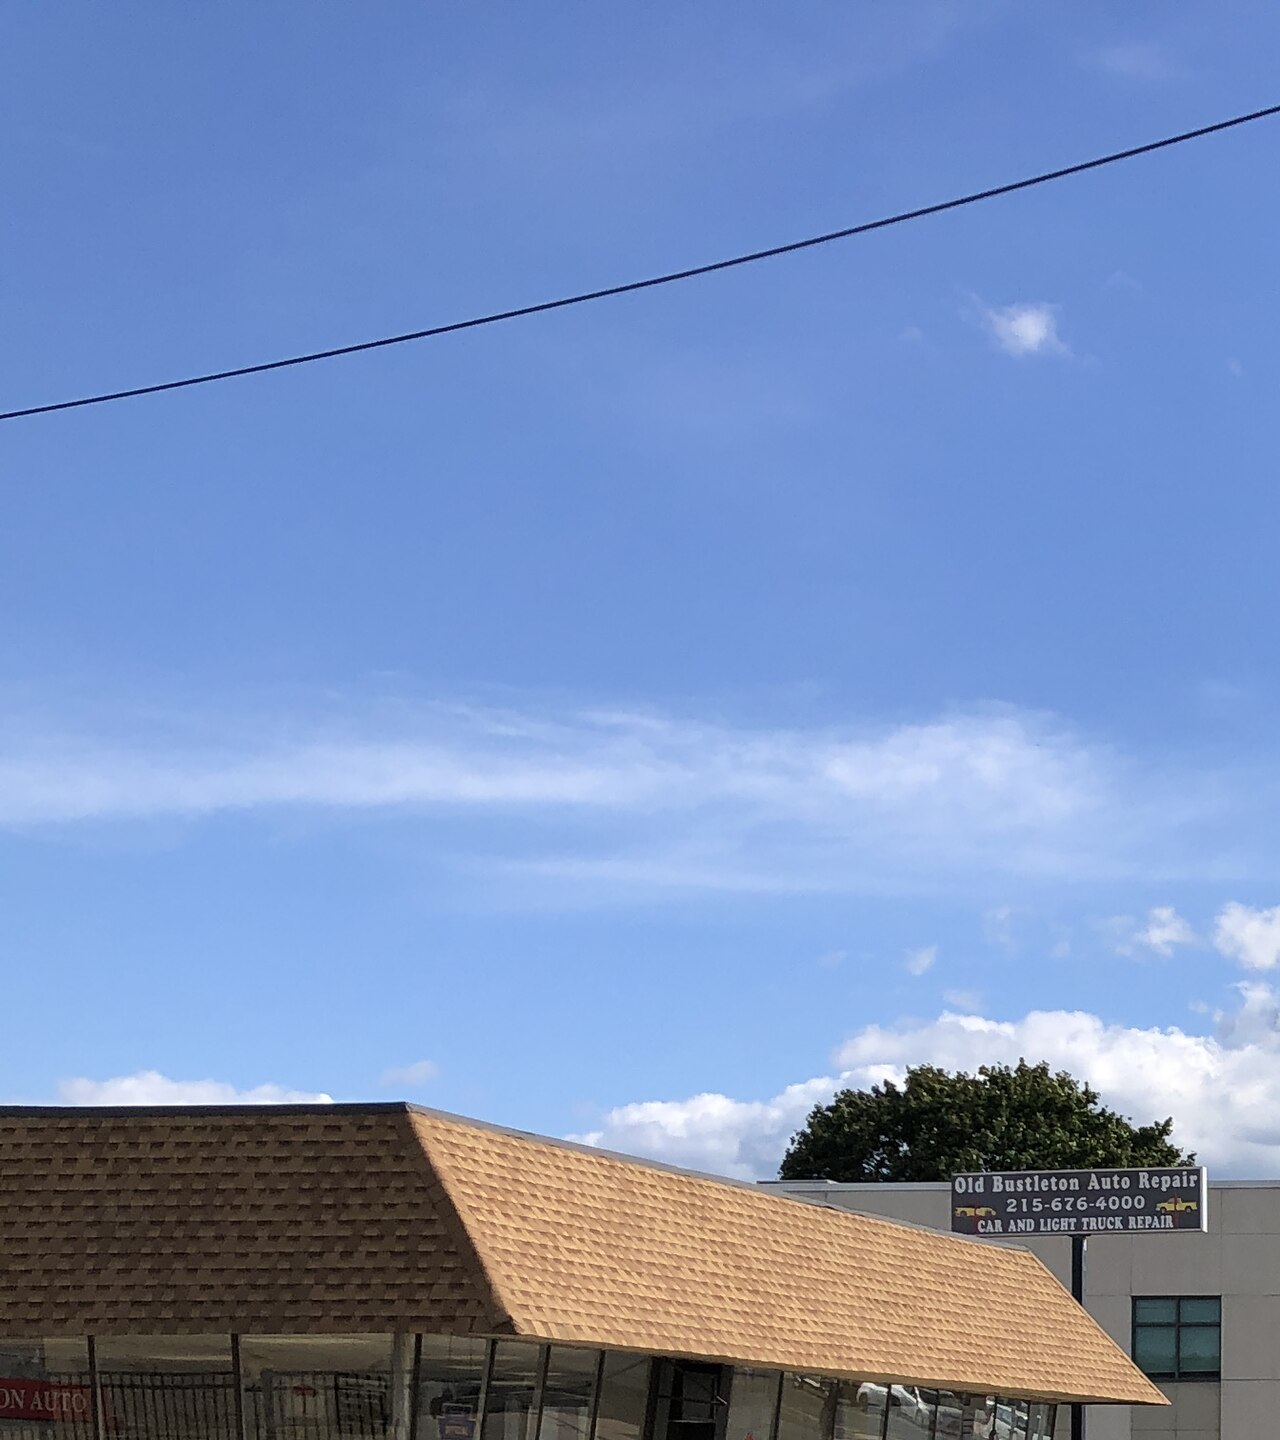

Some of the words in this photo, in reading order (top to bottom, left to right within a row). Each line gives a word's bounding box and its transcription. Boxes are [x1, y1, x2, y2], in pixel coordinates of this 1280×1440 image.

[954, 1177, 985, 1193] Old
[992, 1174, 1080, 1193] Bustleton
[1087, 1173, 1131, 1191] Auto
[1138, 1171, 1198, 1192] Repair
[1006, 1195, 1145, 1213] 215-676-4000
[977, 1219, 1003, 1234] CAR
[1008, 1219, 1035, 1233] AND
[1040, 1218, 1077, 1232] LIGHT
[1082, 1216, 1124, 1231] TRUCK
[1128, 1215, 1174, 1229] REPAIR
[30, 1390, 87, 1412] AUTO
